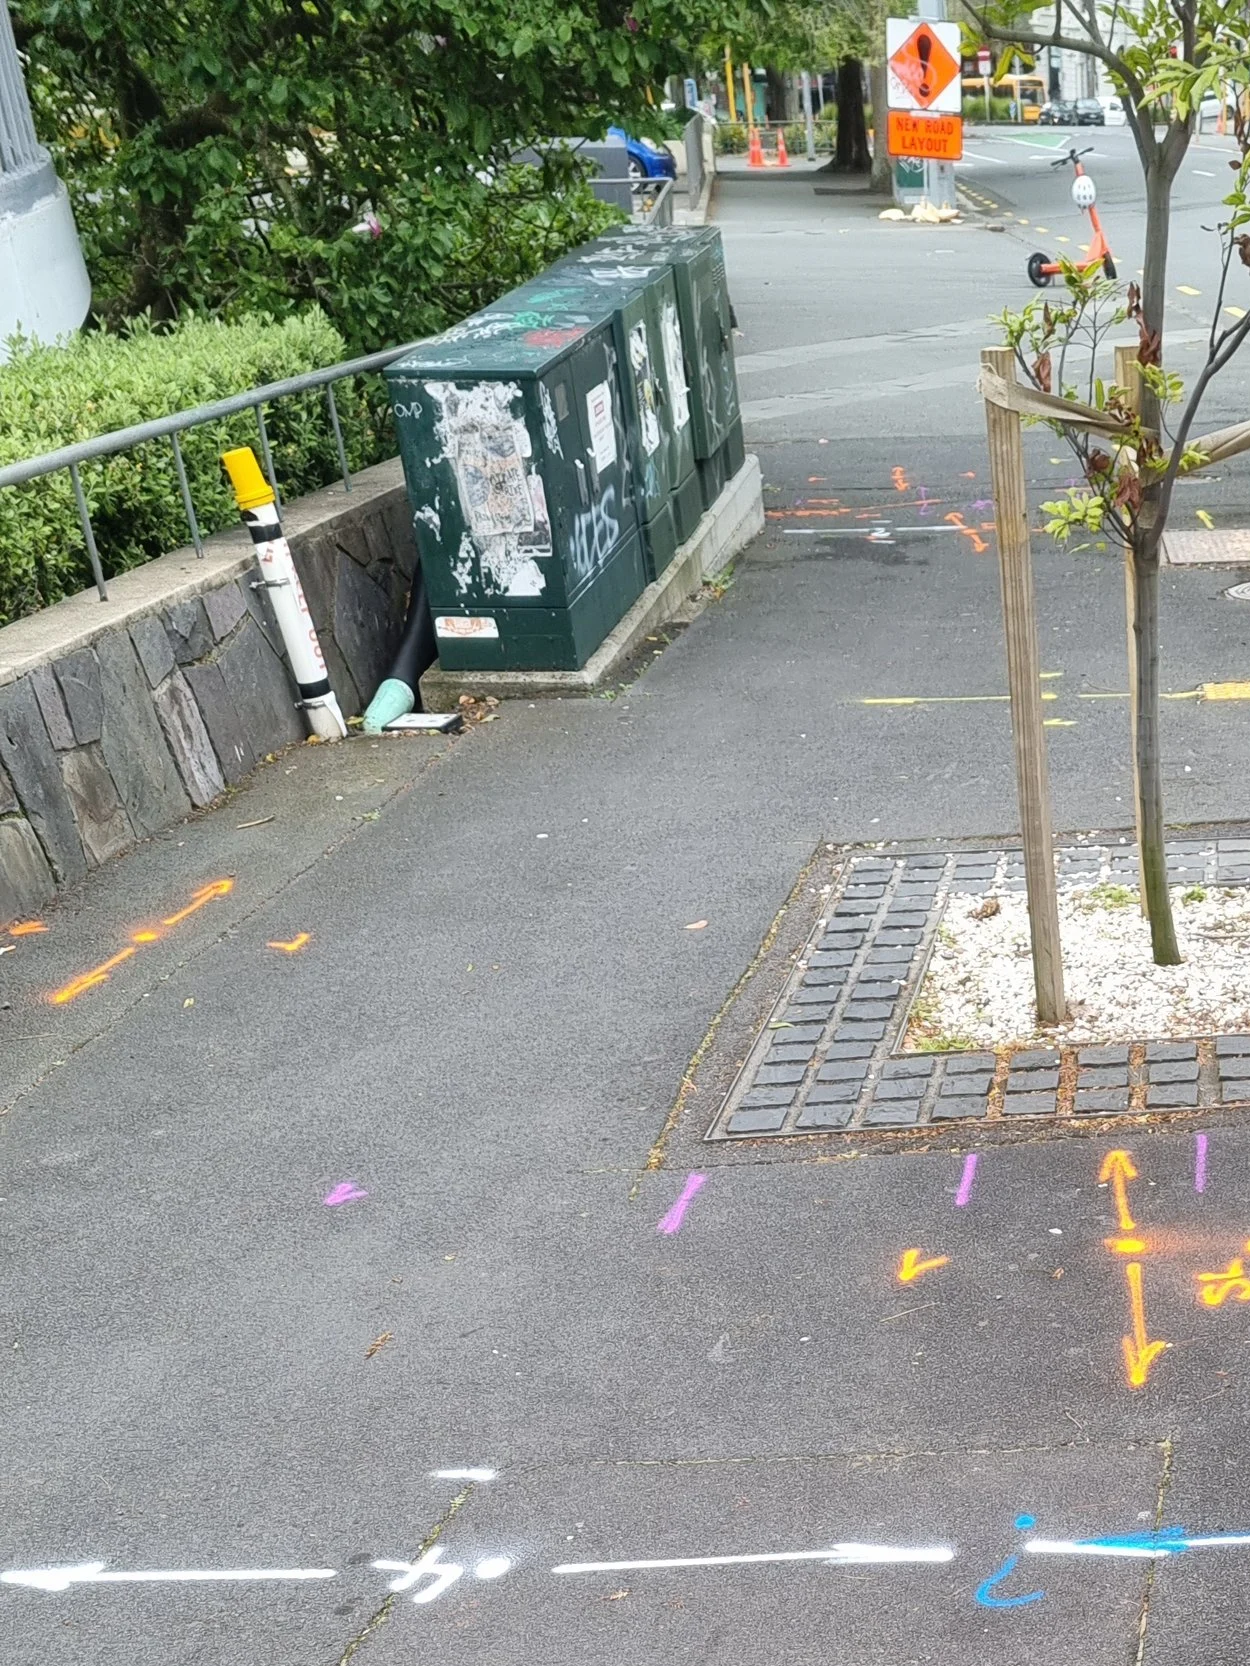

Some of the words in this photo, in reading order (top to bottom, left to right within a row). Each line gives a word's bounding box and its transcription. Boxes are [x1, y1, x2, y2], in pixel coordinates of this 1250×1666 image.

[896, 117, 918, 132] NEW
[924, 120, 954, 136] ROAD
[901, 135, 948, 153] LAYOUT
